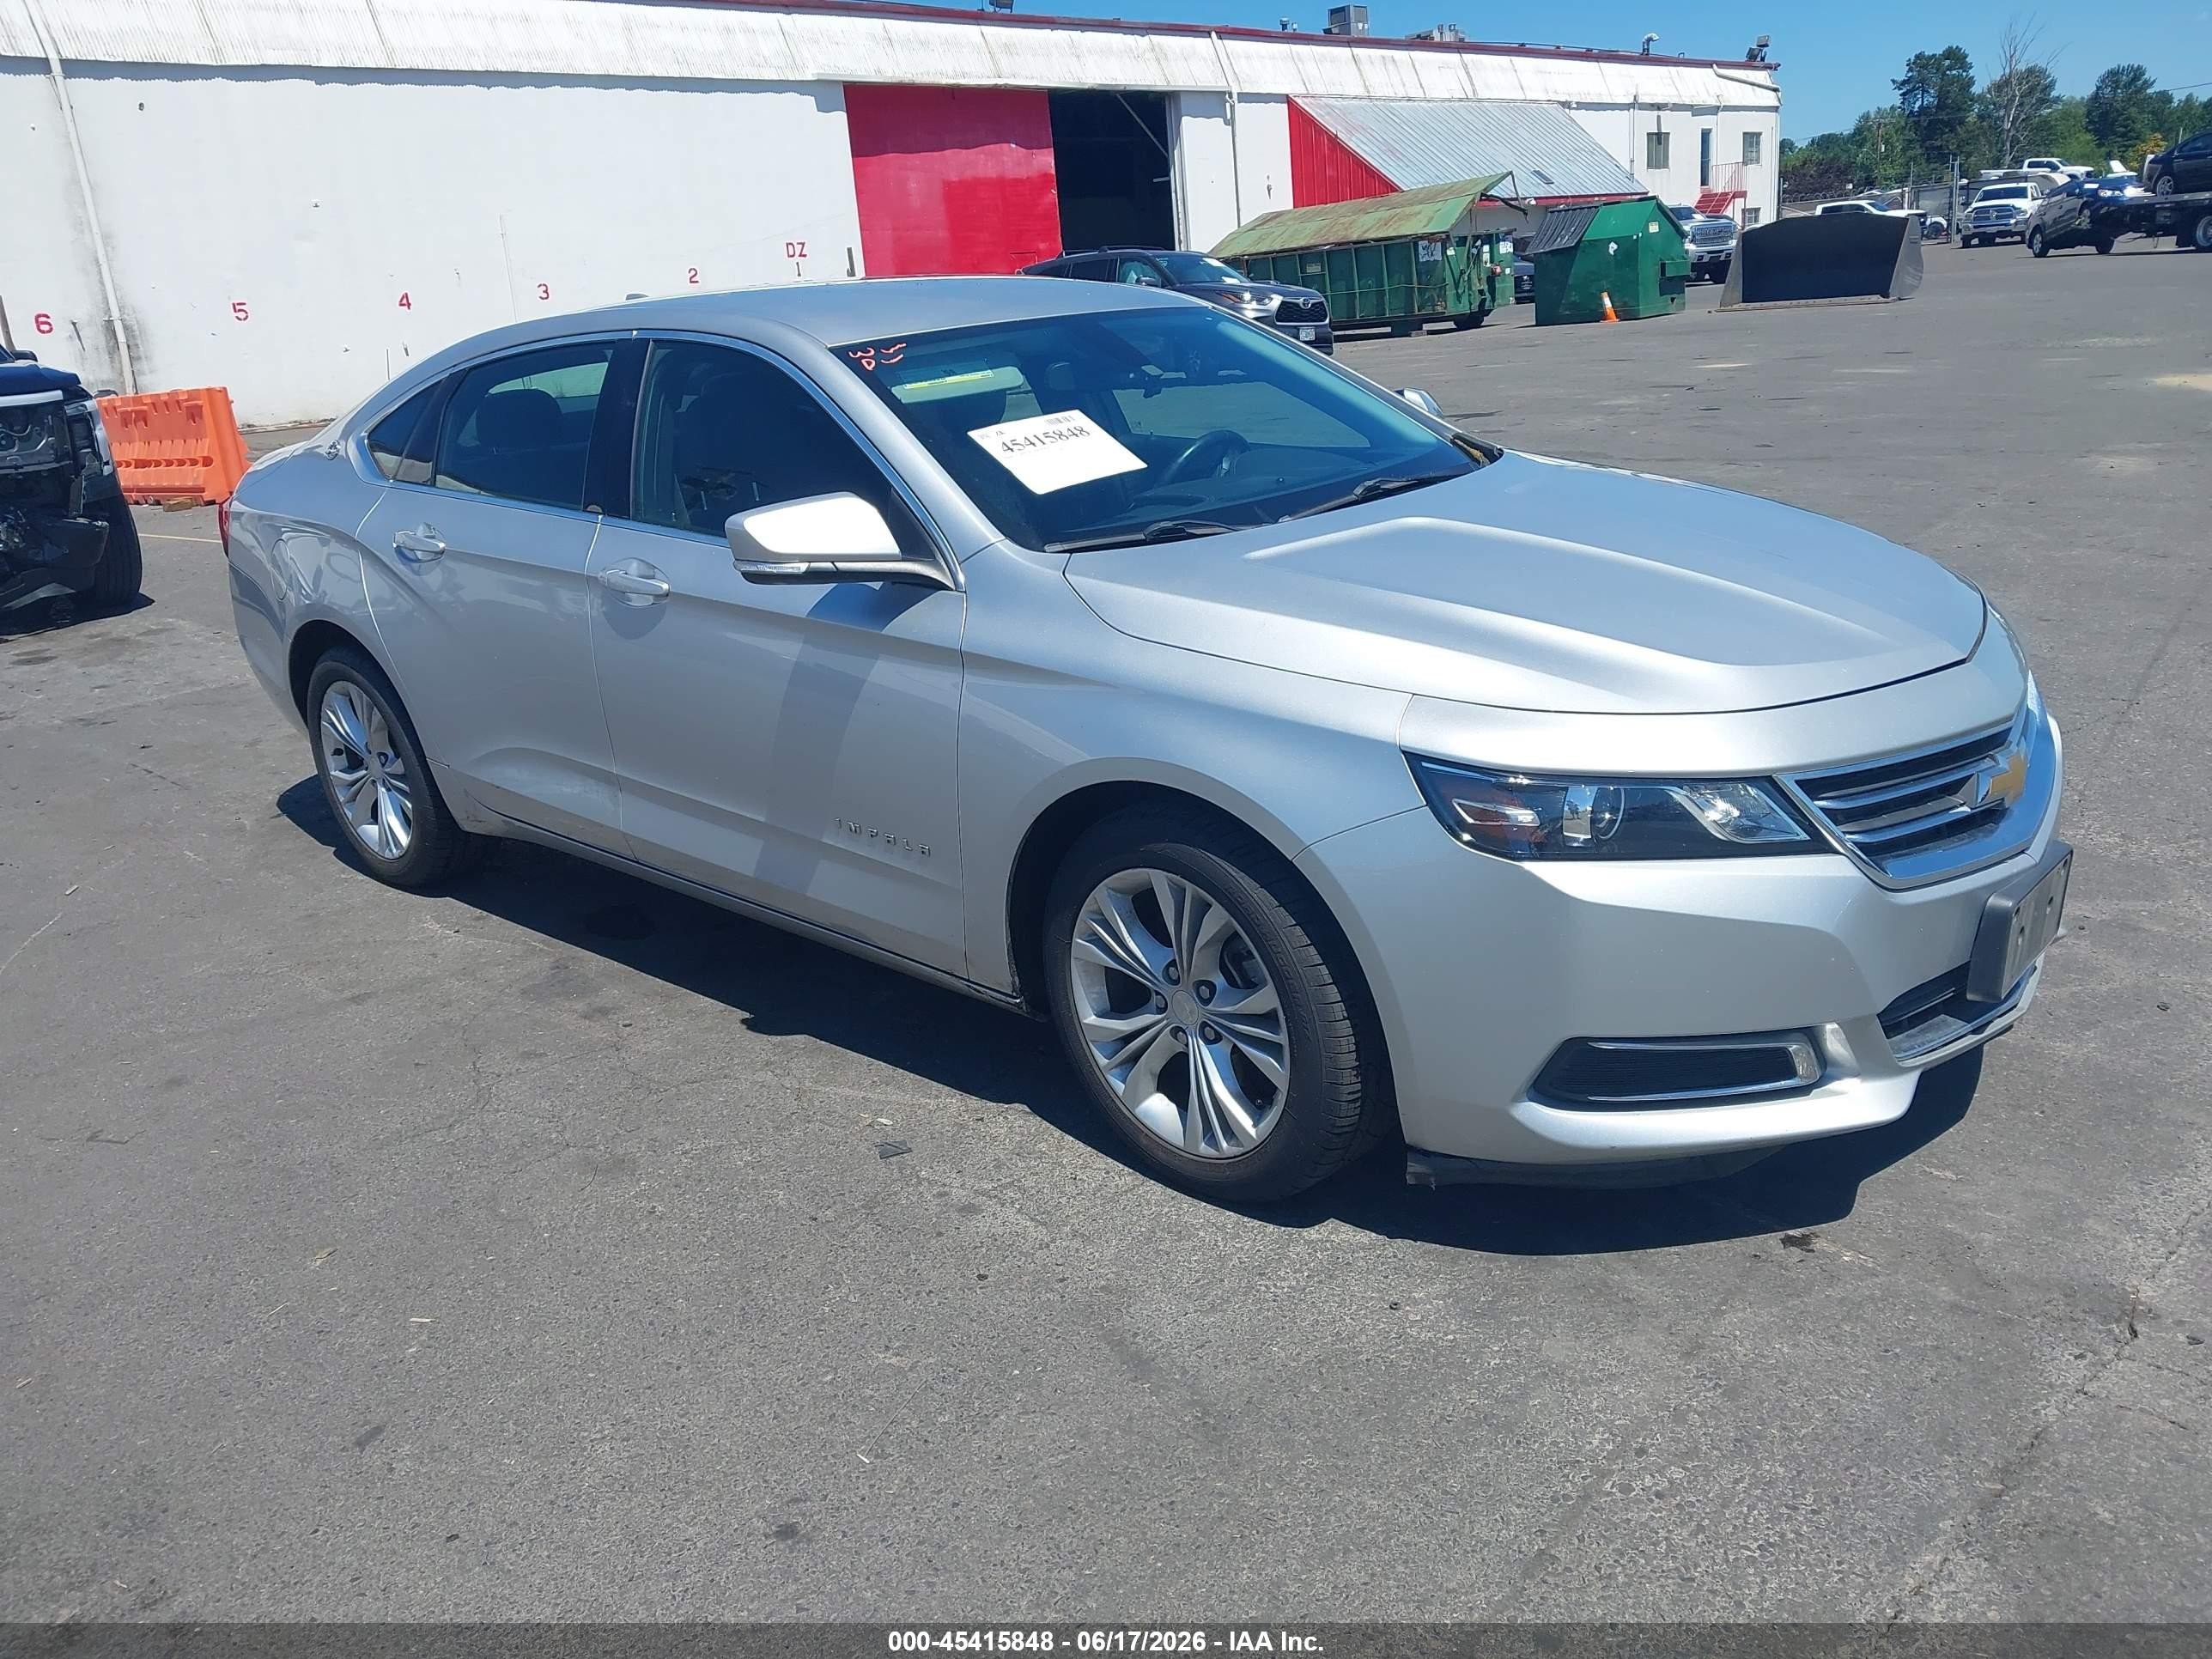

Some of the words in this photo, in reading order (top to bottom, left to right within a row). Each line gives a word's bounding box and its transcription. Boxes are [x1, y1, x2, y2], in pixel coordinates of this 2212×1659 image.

[786, 241, 807, 258] DZ
[688, 267, 699, 284] 2
[796, 261, 802, 277] 1
[398, 292, 412, 310] 4
[538, 283, 550, 301] 3
[232, 301, 249, 321] 5
[34, 313, 54, 335] 6
[1001, 425, 1091, 453] 45415848
[834, 817, 932, 858] IMPALA
